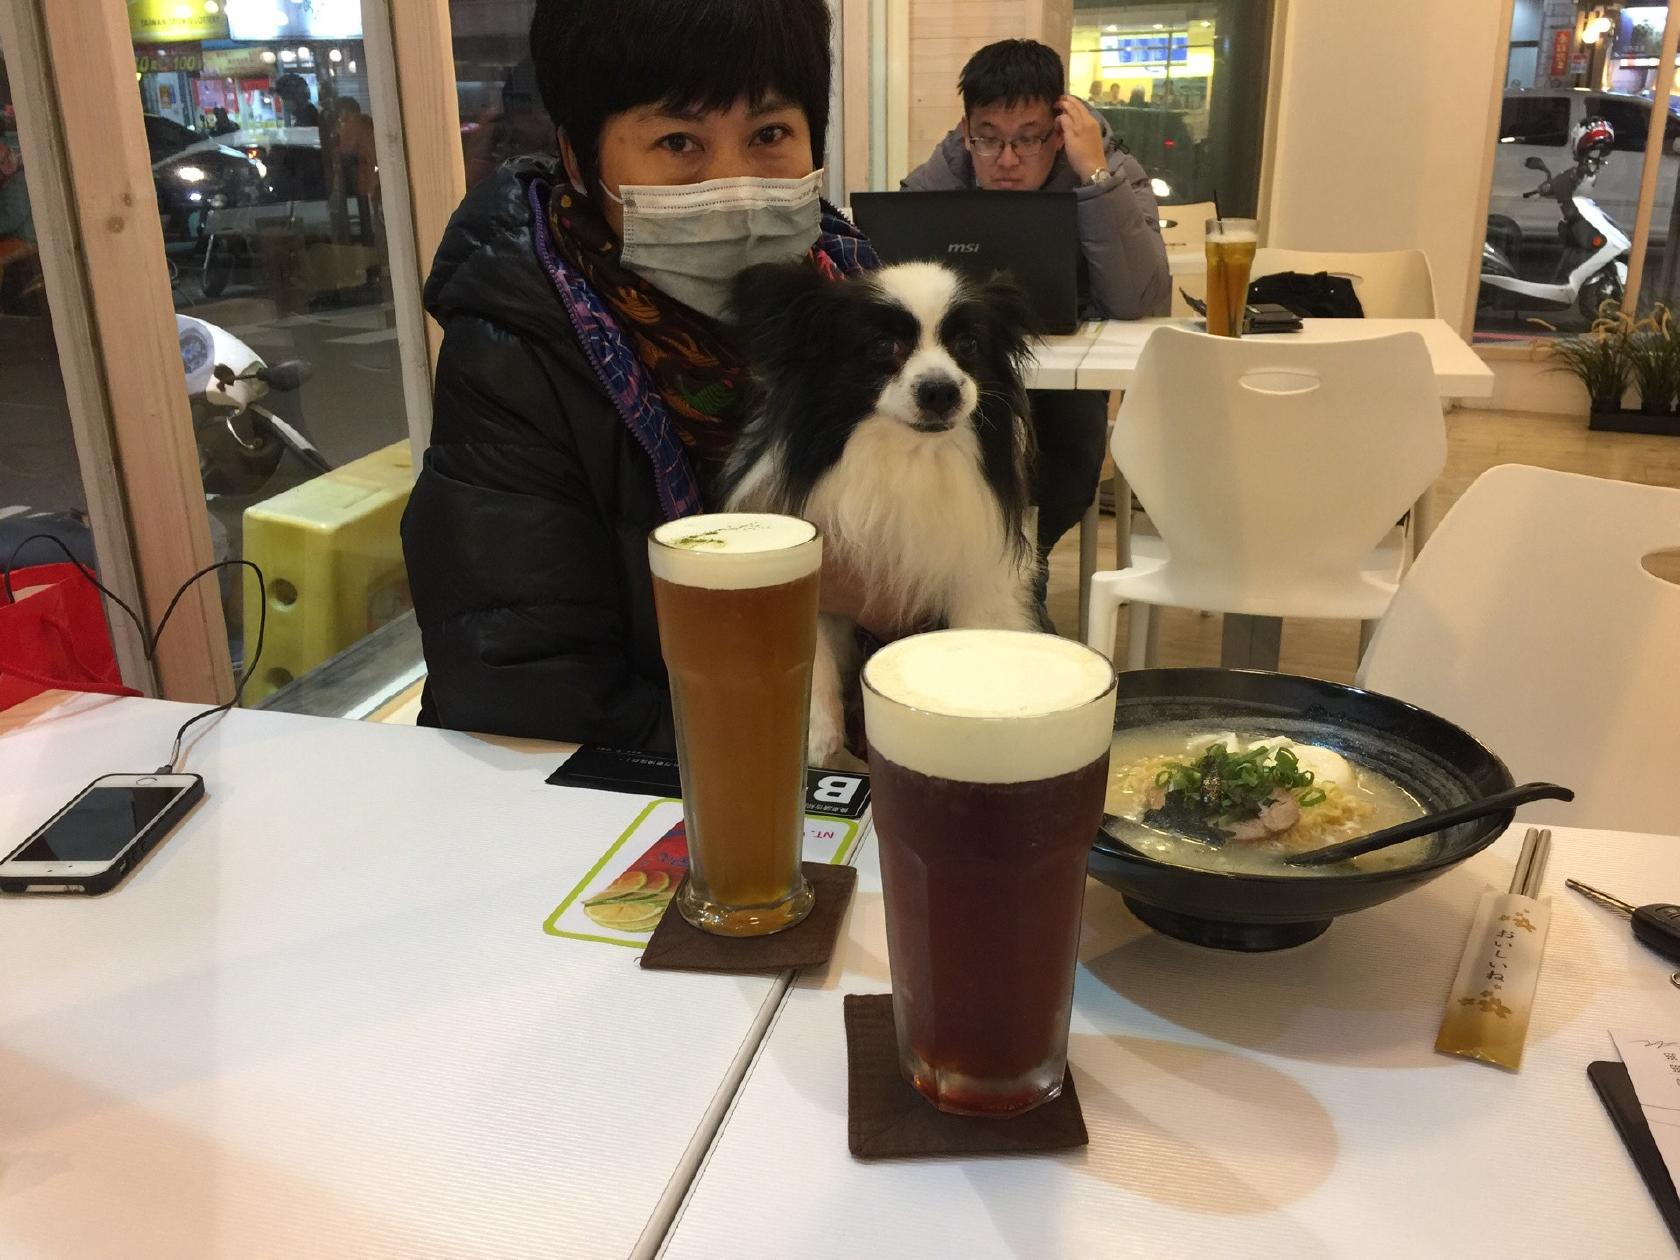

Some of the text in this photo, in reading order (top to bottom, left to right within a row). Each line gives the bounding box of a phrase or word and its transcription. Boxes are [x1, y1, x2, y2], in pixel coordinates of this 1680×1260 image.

[948, 243, 980, 253] msi
[813, 775, 862, 804] B
[1486, 929, 1515, 983] おいしいね
